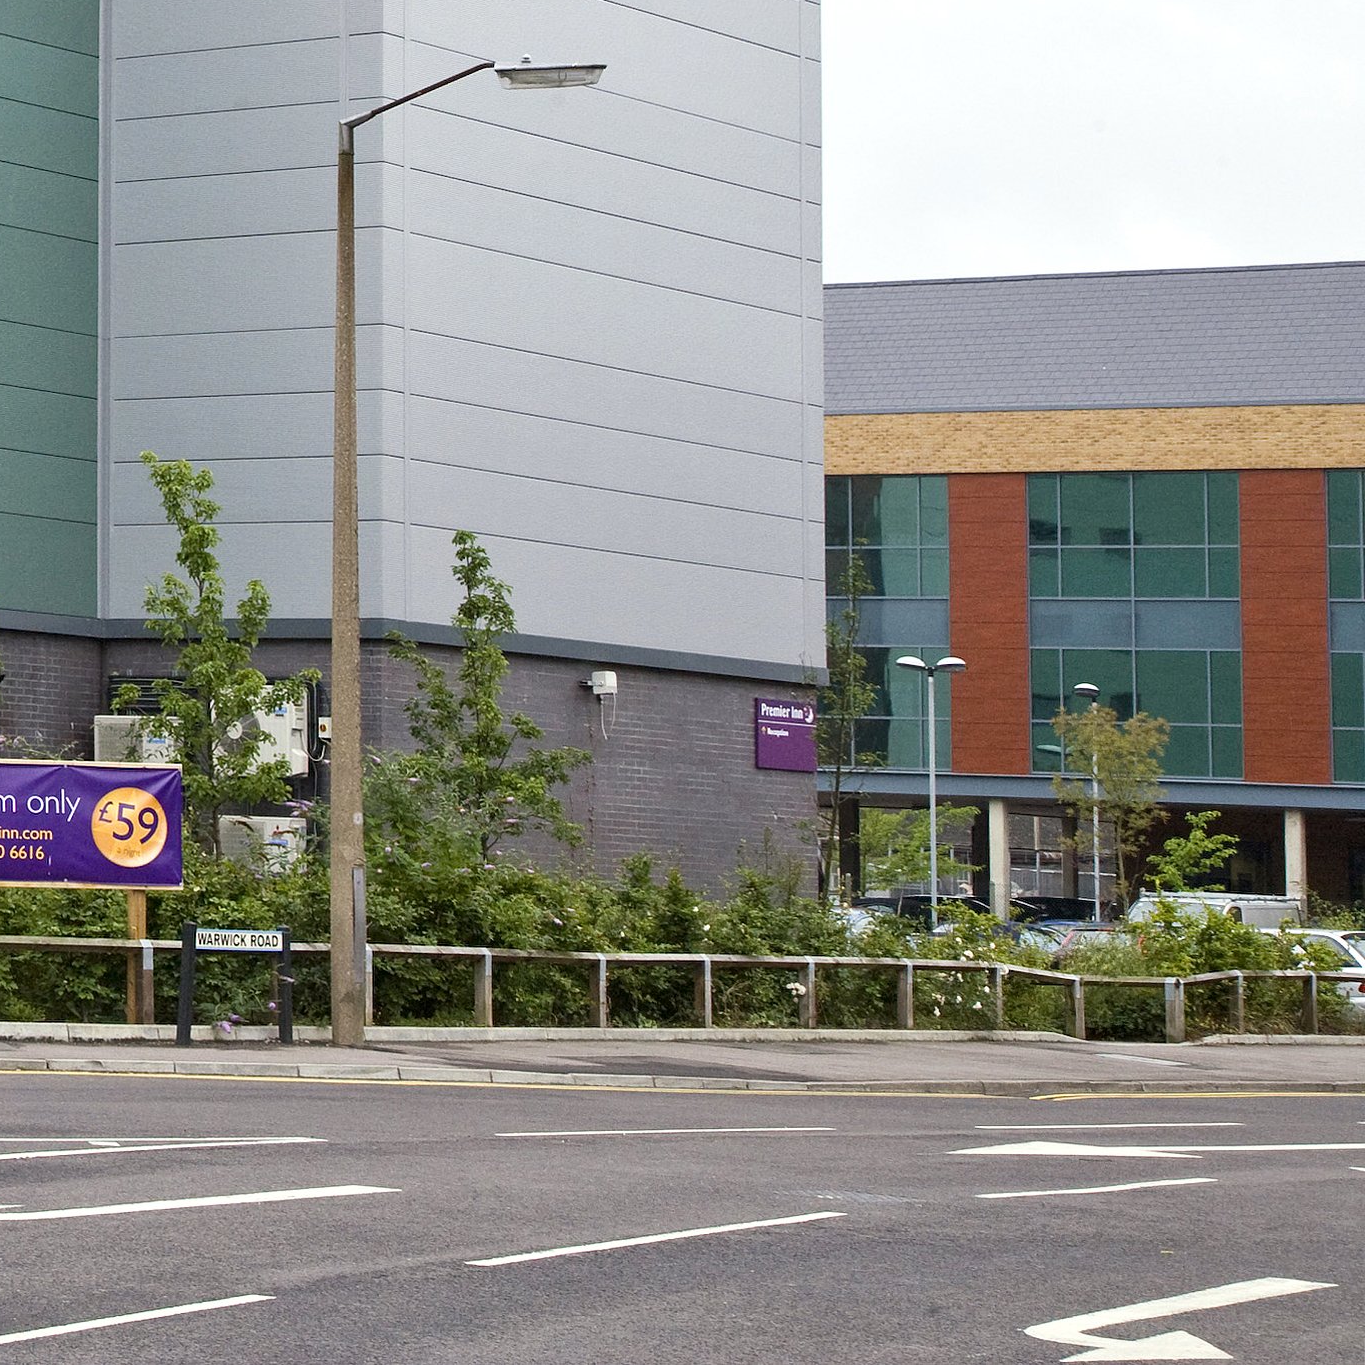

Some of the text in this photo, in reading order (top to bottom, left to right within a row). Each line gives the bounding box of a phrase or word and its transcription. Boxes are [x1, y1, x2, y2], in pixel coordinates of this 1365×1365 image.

[761, 702, 804, 720] Premier Inn
[26, 788, 81, 822] only
[99, 801, 159, 844] £59
[9, 845, 45, 860] 6616
[197, 933, 279, 947] WARWICK ROAD
